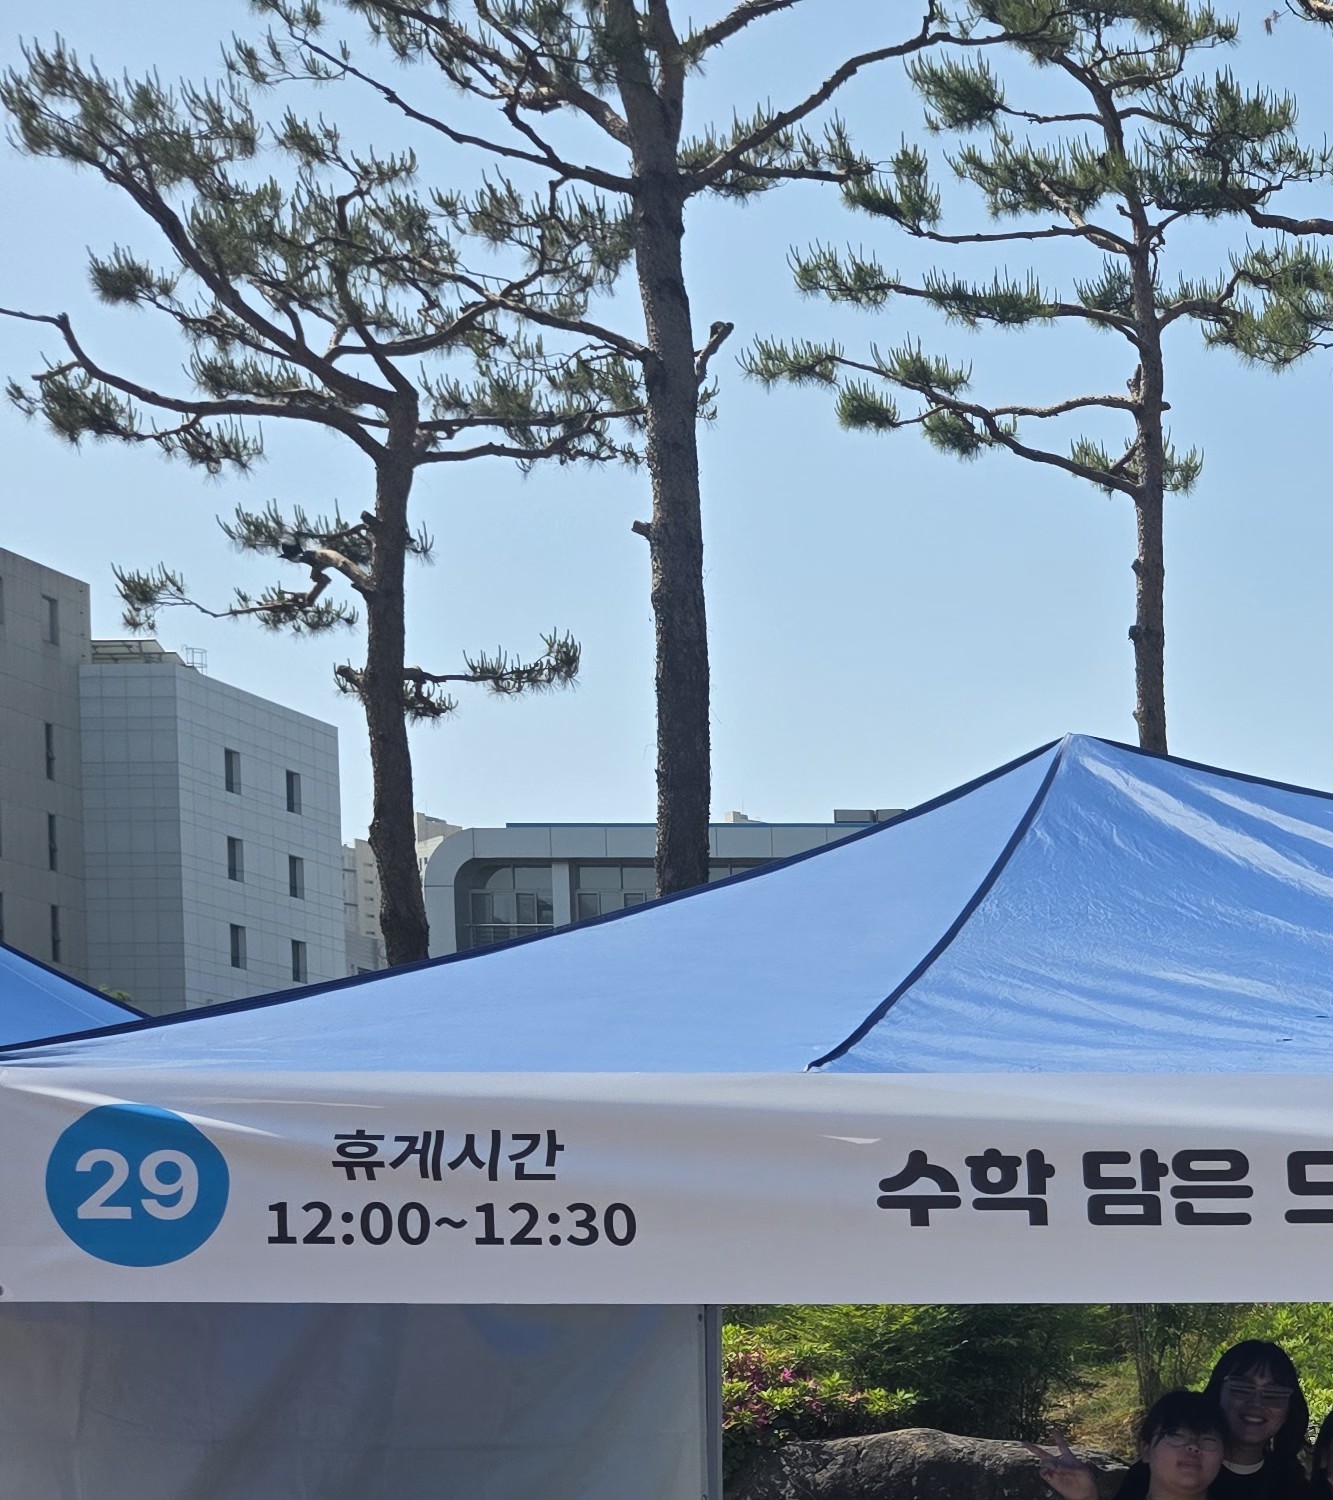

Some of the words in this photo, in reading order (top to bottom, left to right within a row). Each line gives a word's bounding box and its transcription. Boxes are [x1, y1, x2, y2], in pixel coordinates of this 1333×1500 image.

[74, 1149, 200, 1220] 29
[331, 1129, 565, 1182] 휴게시간
[876, 1148, 1055, 1227] 수학
[1081, 1148, 1254, 1226] 담은
[266, 1200, 637, 1248] 12:00~12:30
